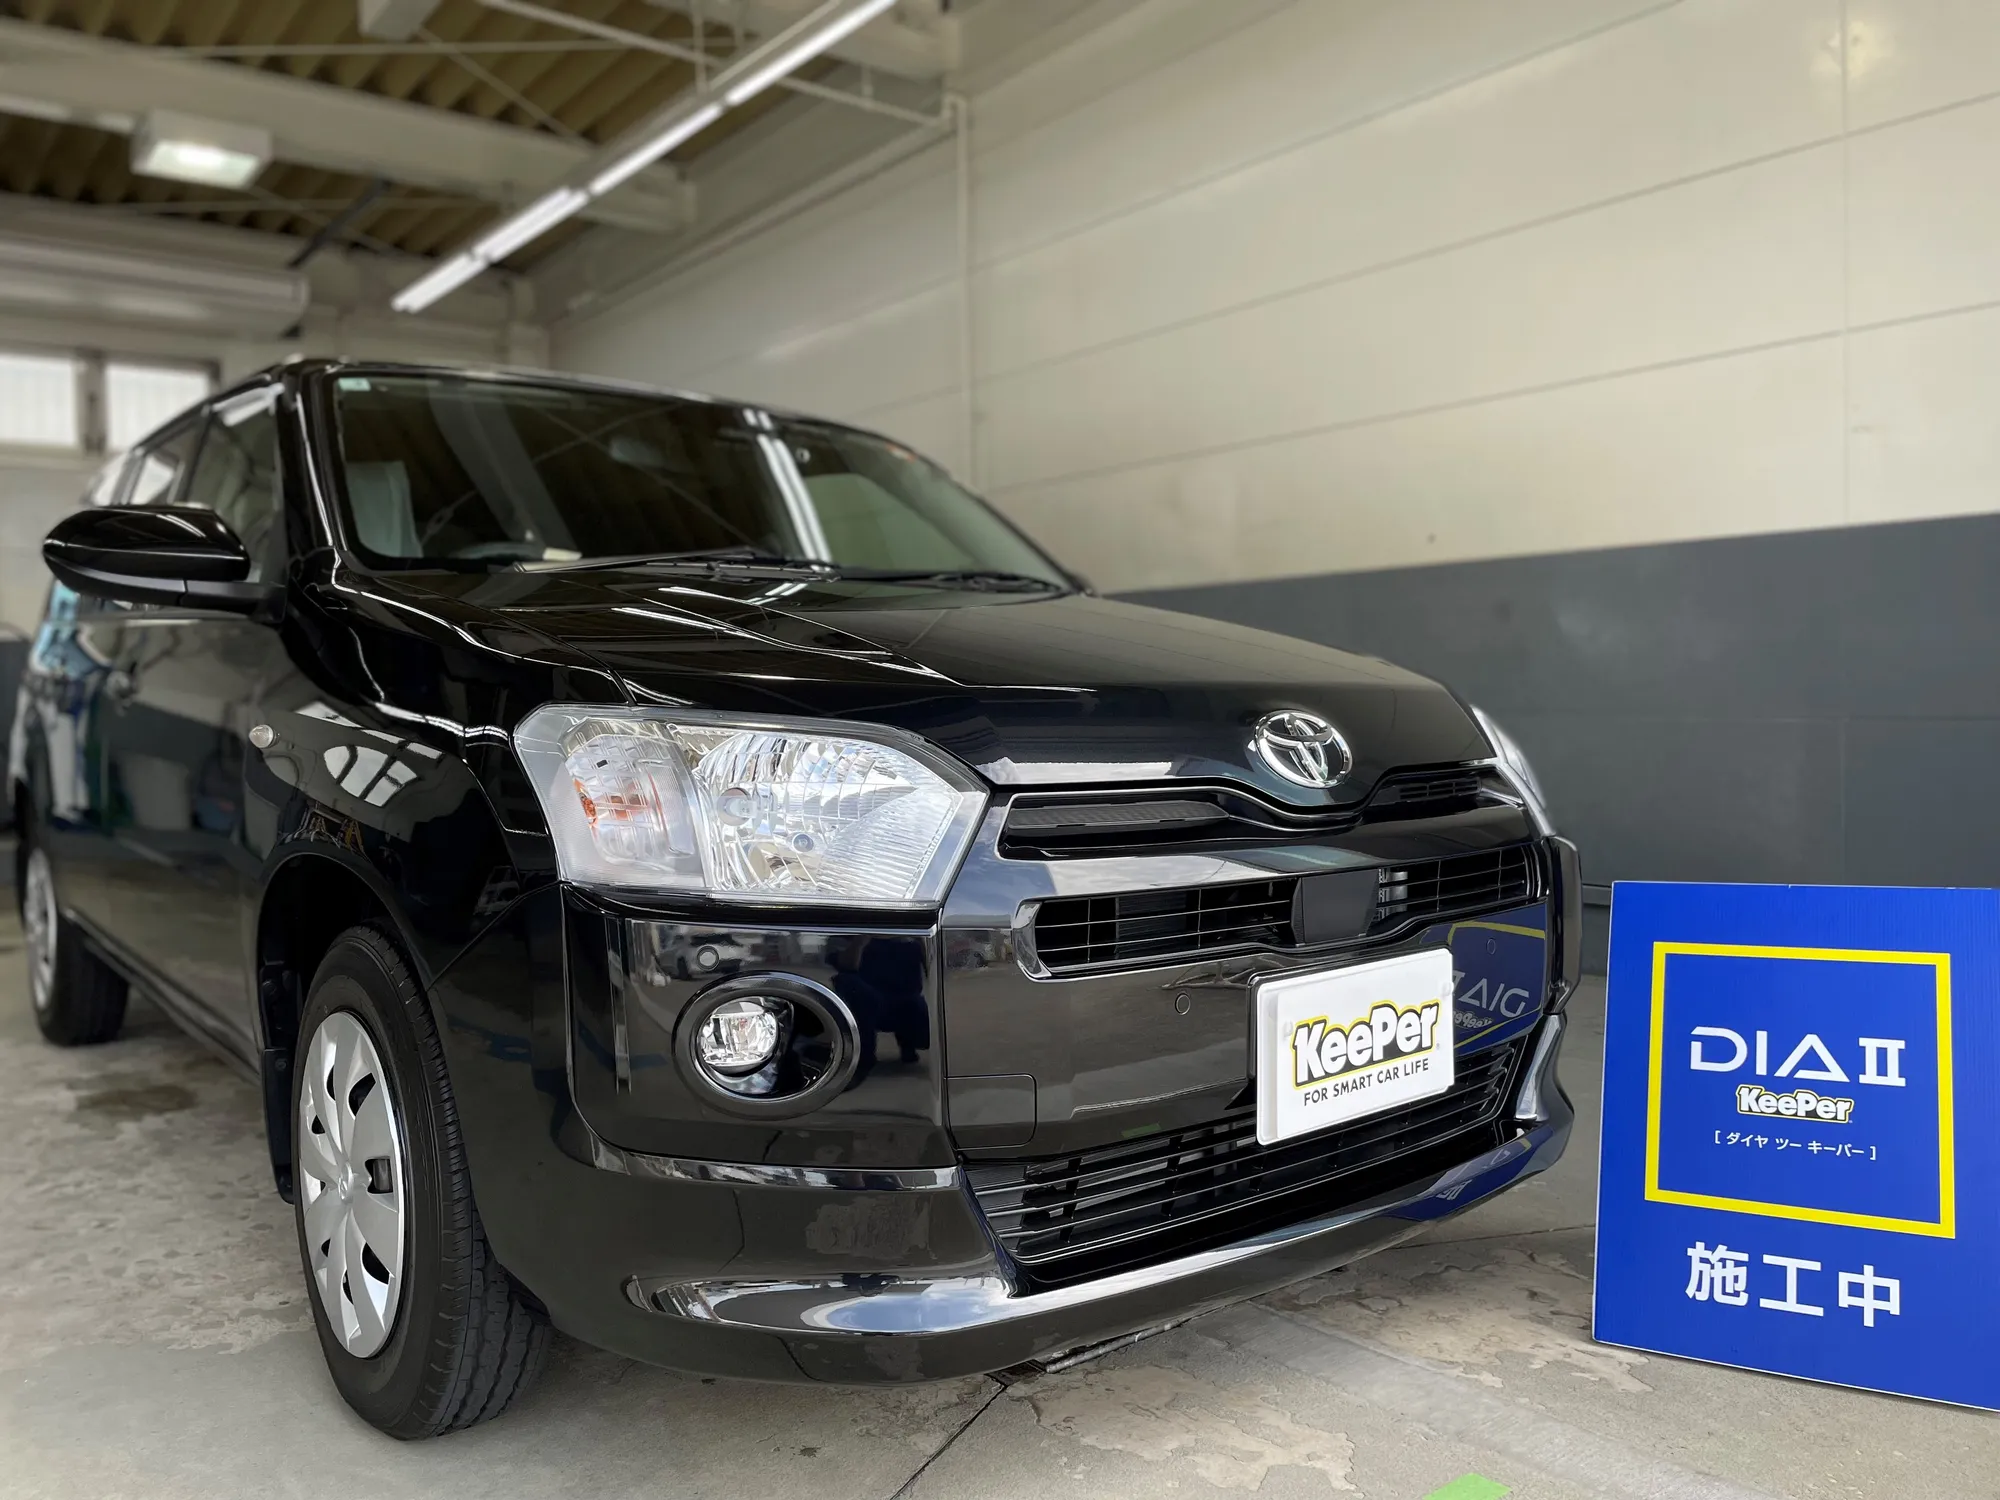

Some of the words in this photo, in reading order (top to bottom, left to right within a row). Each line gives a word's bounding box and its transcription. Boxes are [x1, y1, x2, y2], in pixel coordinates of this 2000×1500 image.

[1293, 1001, 1440, 1087] KeePer
[1304, 1087, 1328, 1106] FOR
[1333, 1074, 1373, 1098] SMART
[1377, 1065, 1400, 1084] CAR
[1404, 1058, 1429, 1077] LIFE
[1738, 1085, 1853, 1122] KeePer
[1685, 1241, 1900, 1328] 施工中
